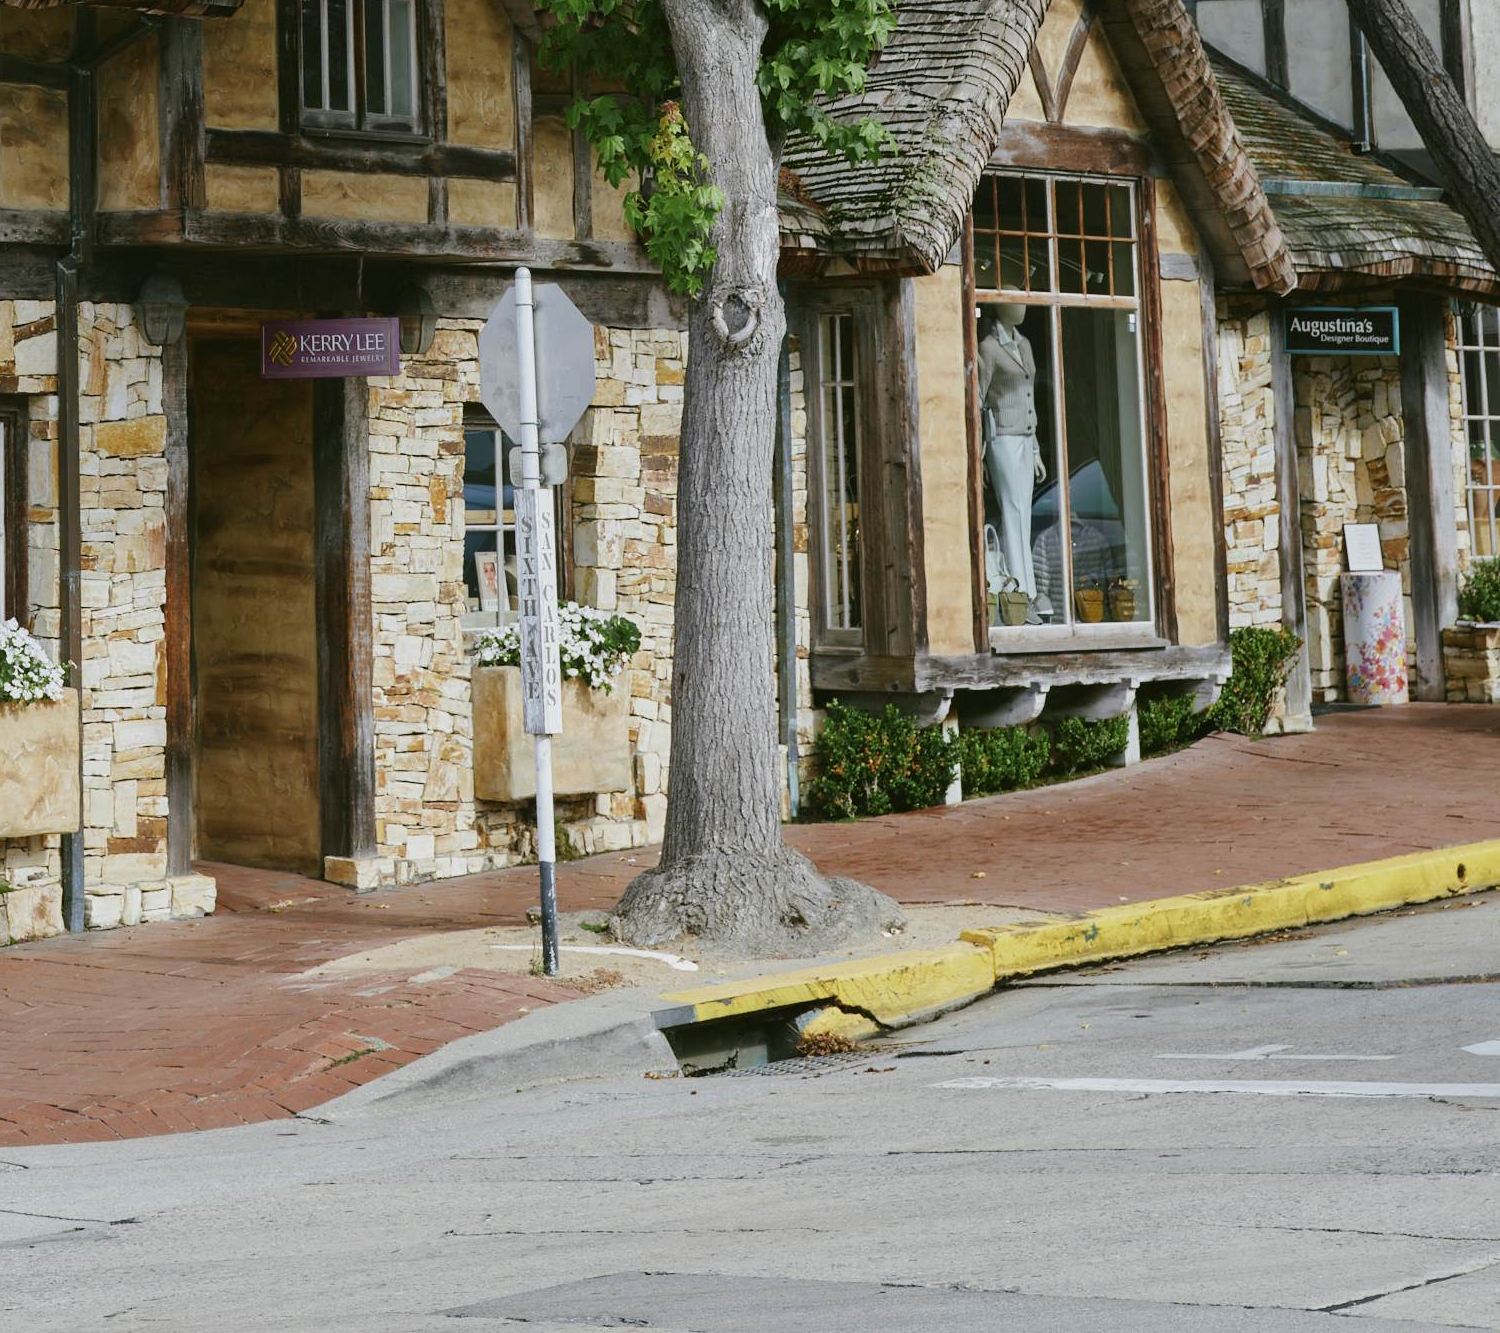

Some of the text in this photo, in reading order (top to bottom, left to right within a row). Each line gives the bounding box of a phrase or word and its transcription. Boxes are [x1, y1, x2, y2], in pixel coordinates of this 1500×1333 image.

[1290, 317, 1373, 337] Augustina's
[300, 333, 385, 355] KERRY LEE
[1320, 334, 1389, 345] Designer Boutique
[301, 354, 385, 363] REMARKABLE JEWELRY
[521, 516, 540, 699] SIXTH AVE
[541, 511, 557, 707] SAN CARLOS
